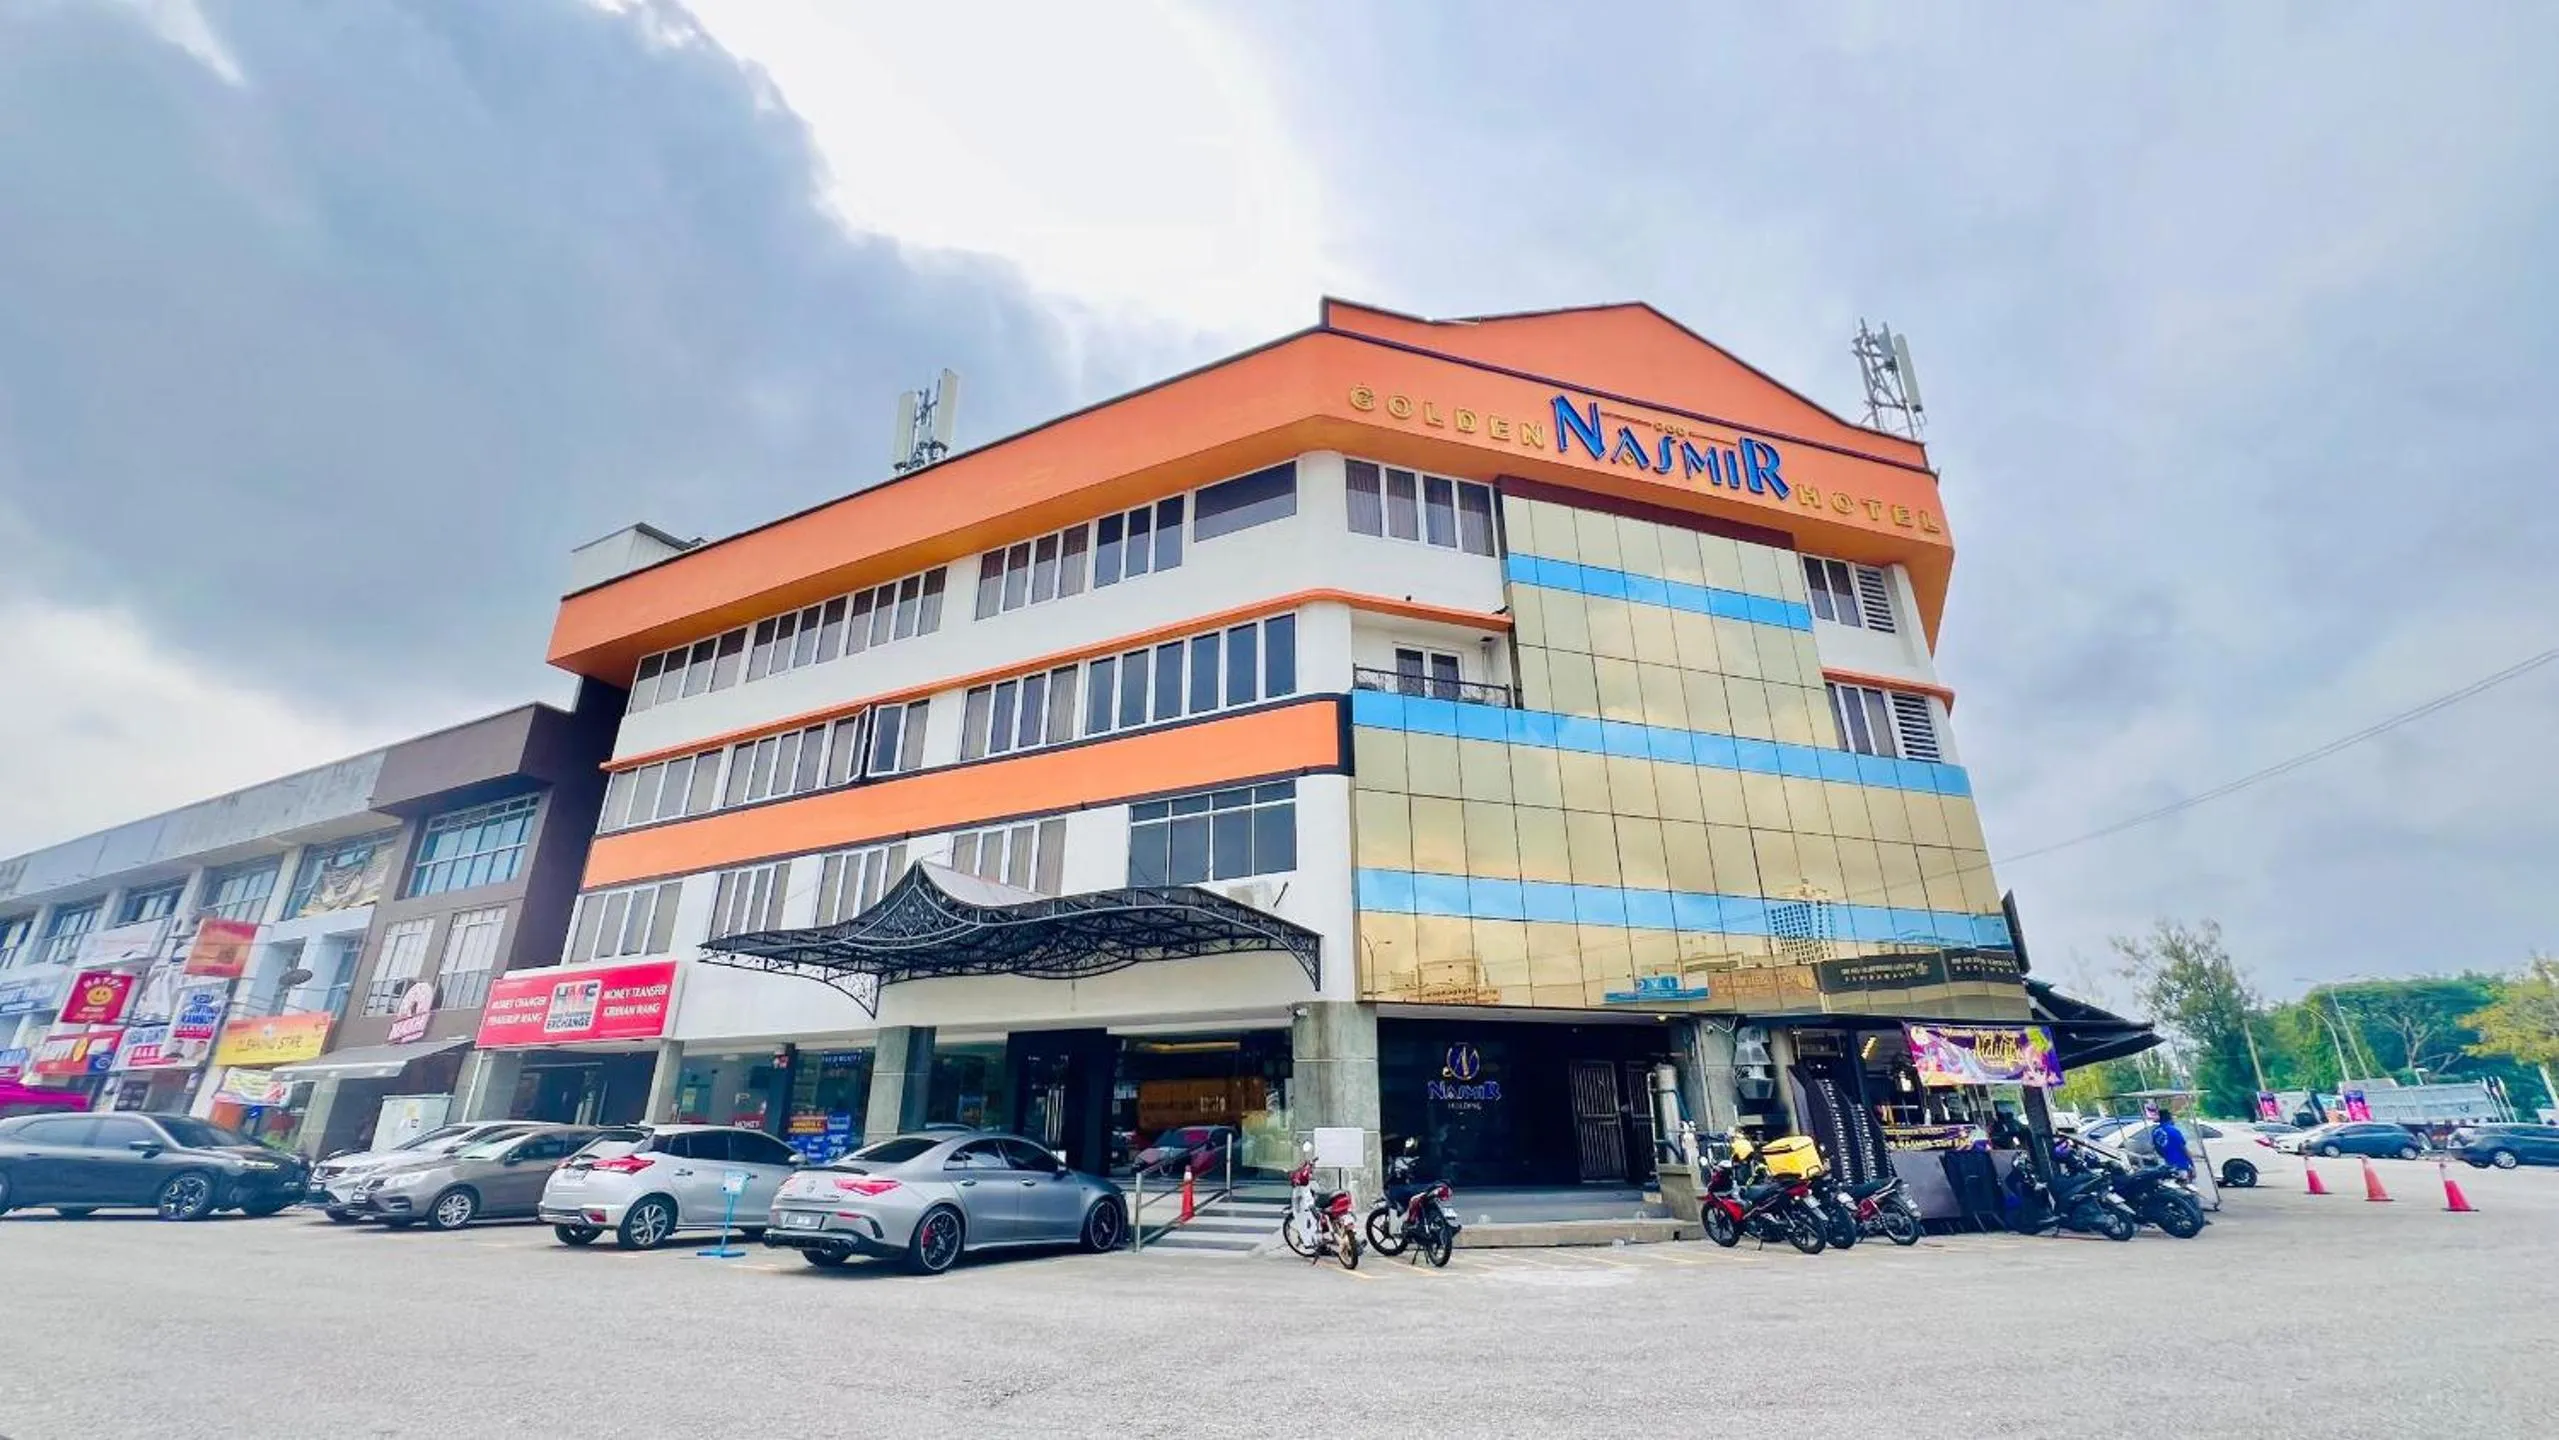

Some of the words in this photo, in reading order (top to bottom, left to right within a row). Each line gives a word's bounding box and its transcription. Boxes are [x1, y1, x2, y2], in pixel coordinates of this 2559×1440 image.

[1350, 384, 1545, 449] GOLDEN
[1550, 394, 1790, 500] NASMIR
[1796, 482, 1941, 533] HOTEL
[547, 1016, 591, 1029] EXCHANGE
[1427, 1080, 1503, 1101] NASMIR
